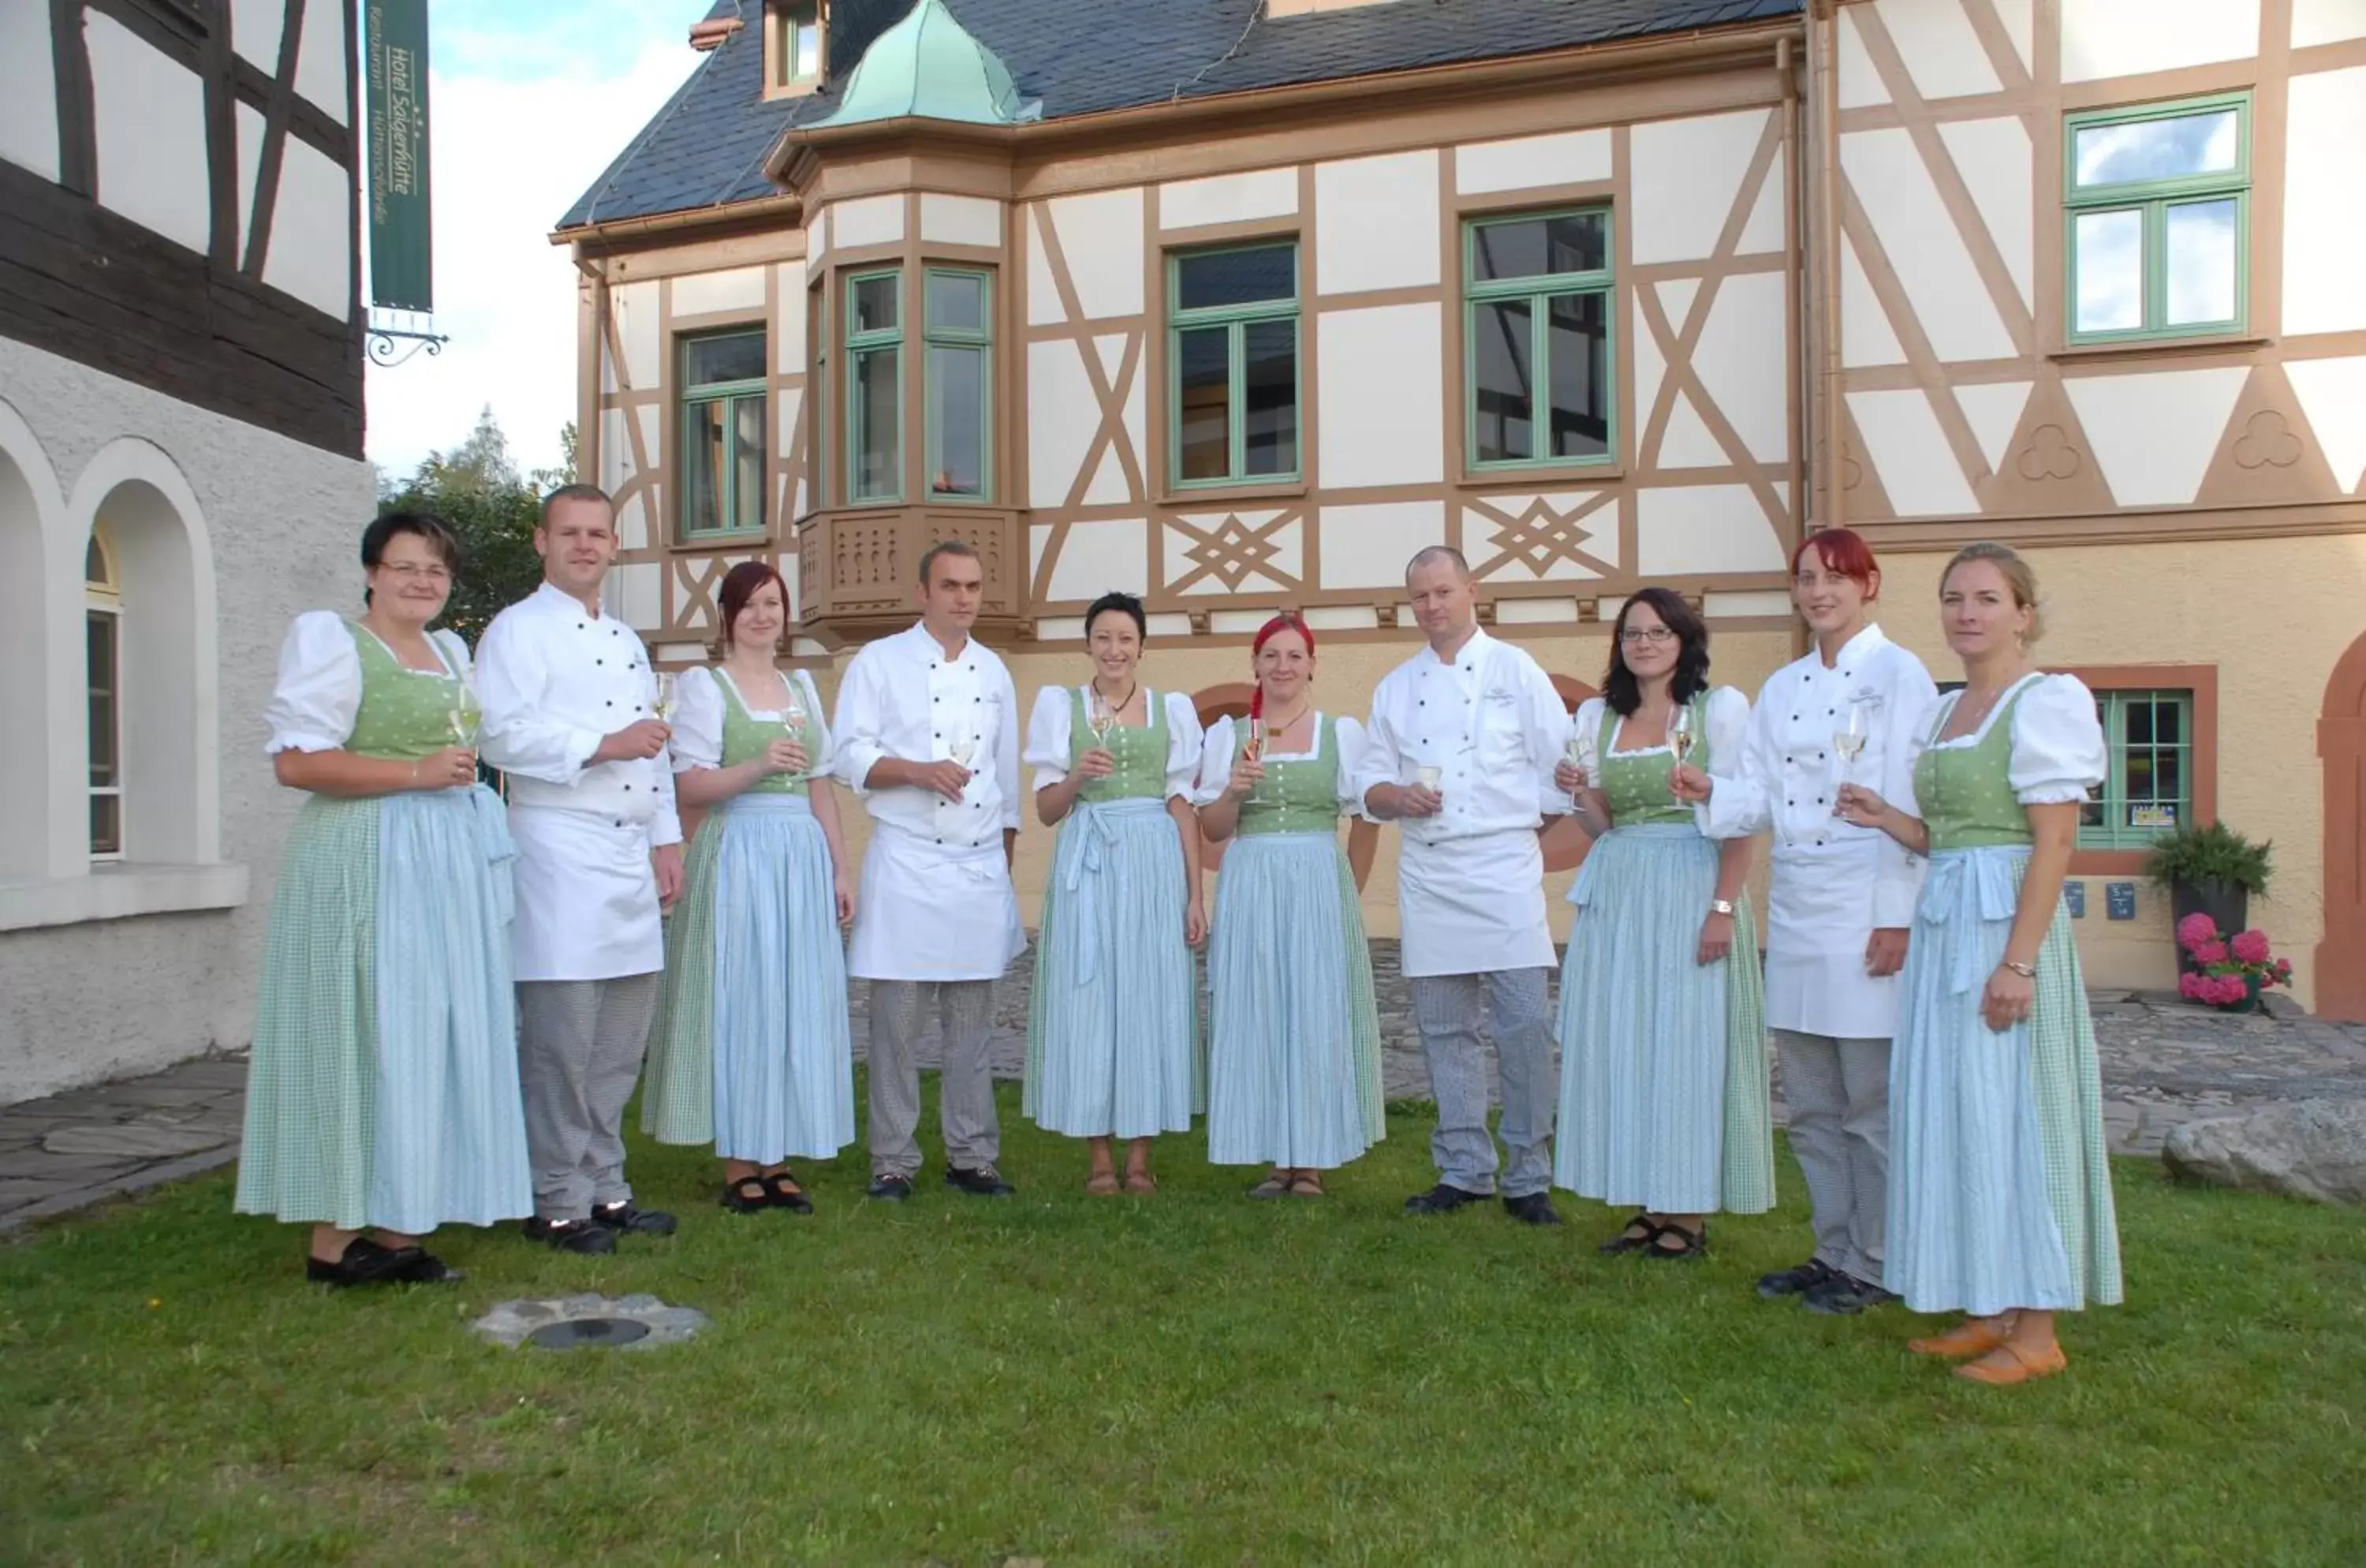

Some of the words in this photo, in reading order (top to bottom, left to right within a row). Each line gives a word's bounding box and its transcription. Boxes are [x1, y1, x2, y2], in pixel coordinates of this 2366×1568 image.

[370, 6, 384, 90] Restaurant
[391, 47, 411, 93] Hotel
[390, 96, 412, 195] Saigerhütte
